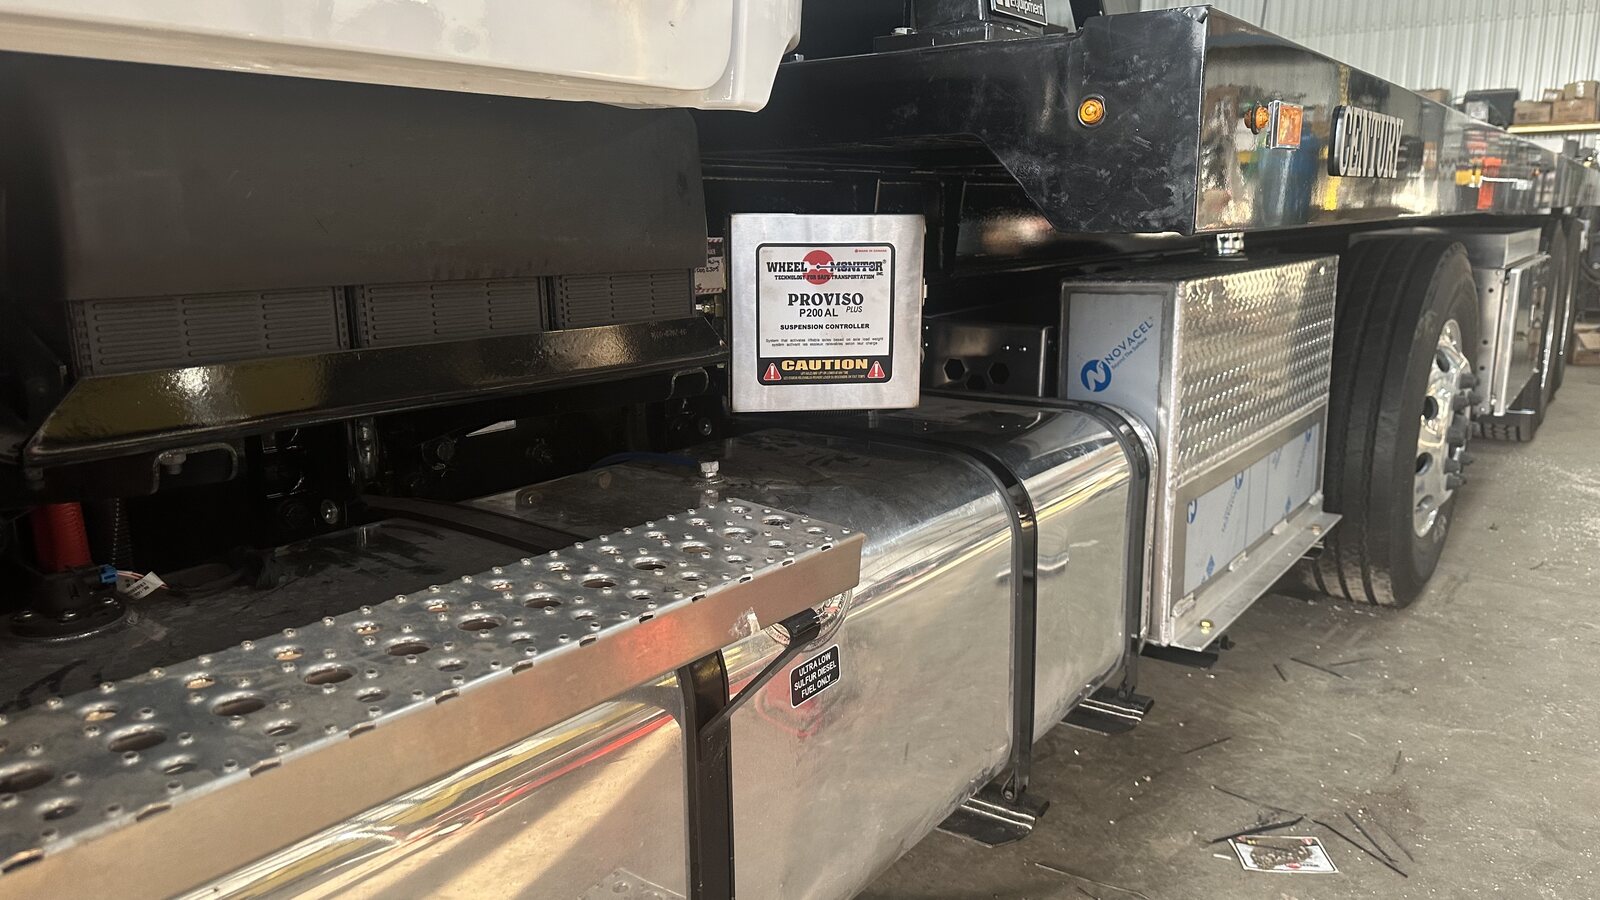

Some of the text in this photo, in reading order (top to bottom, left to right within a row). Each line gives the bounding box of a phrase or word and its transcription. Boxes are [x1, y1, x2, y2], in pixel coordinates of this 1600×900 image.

[1339, 106, 1404, 178] CENTURY
[766, 261, 884, 273] WHEEL MONITOR
[787, 292, 864, 306] PROVISO
[845, 305, 863, 313] PLUS
[1104, 320, 1153, 365] NOVACEL
[781, 359, 868, 371] CAUTION
[794, 660, 837, 691] SULFUR DIESEL
[798, 651, 831, 677] ULTRA LOW
[801, 673, 831, 698] FUEL ONLY
